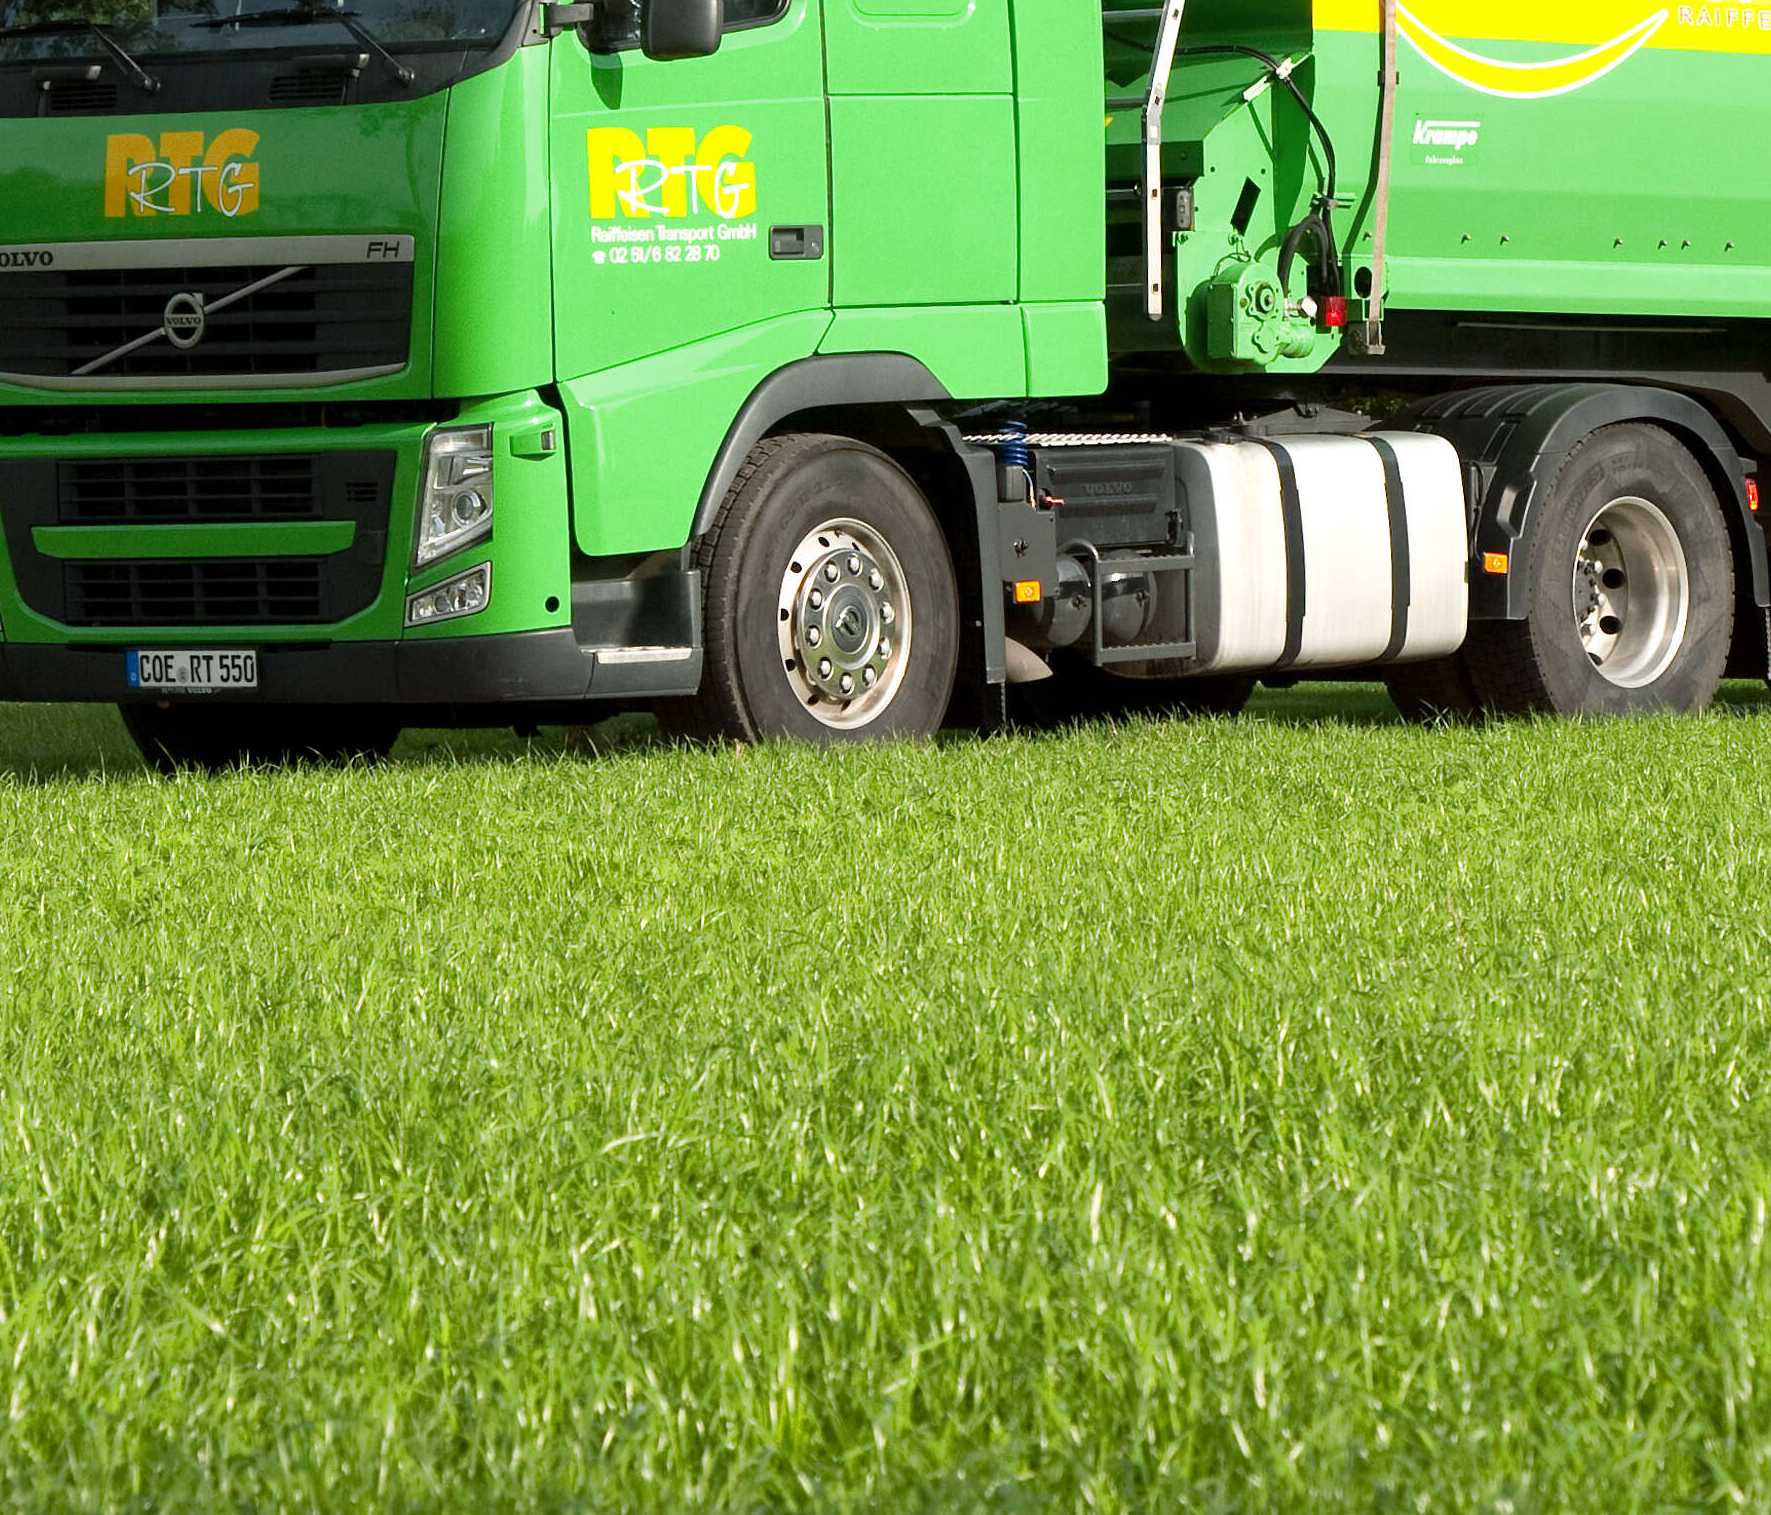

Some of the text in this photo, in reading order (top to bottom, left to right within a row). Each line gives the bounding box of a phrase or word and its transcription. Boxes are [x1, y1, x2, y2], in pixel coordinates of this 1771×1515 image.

[104, 128, 260, 218] RTG
[586, 124, 757, 219] RTG
[591, 223, 757, 244] Raiffeisen Transport GmbH
[366, 241, 400, 259] FH
[609, 247, 628, 263] 02
[664, 246, 681, 262] 82
[703, 244, 720, 261] 70
[166, 316, 201, 325] VOLVO
[139, 655, 177, 683] COE
[190, 655, 213, 683] RT
[219, 655, 255, 683] 550
